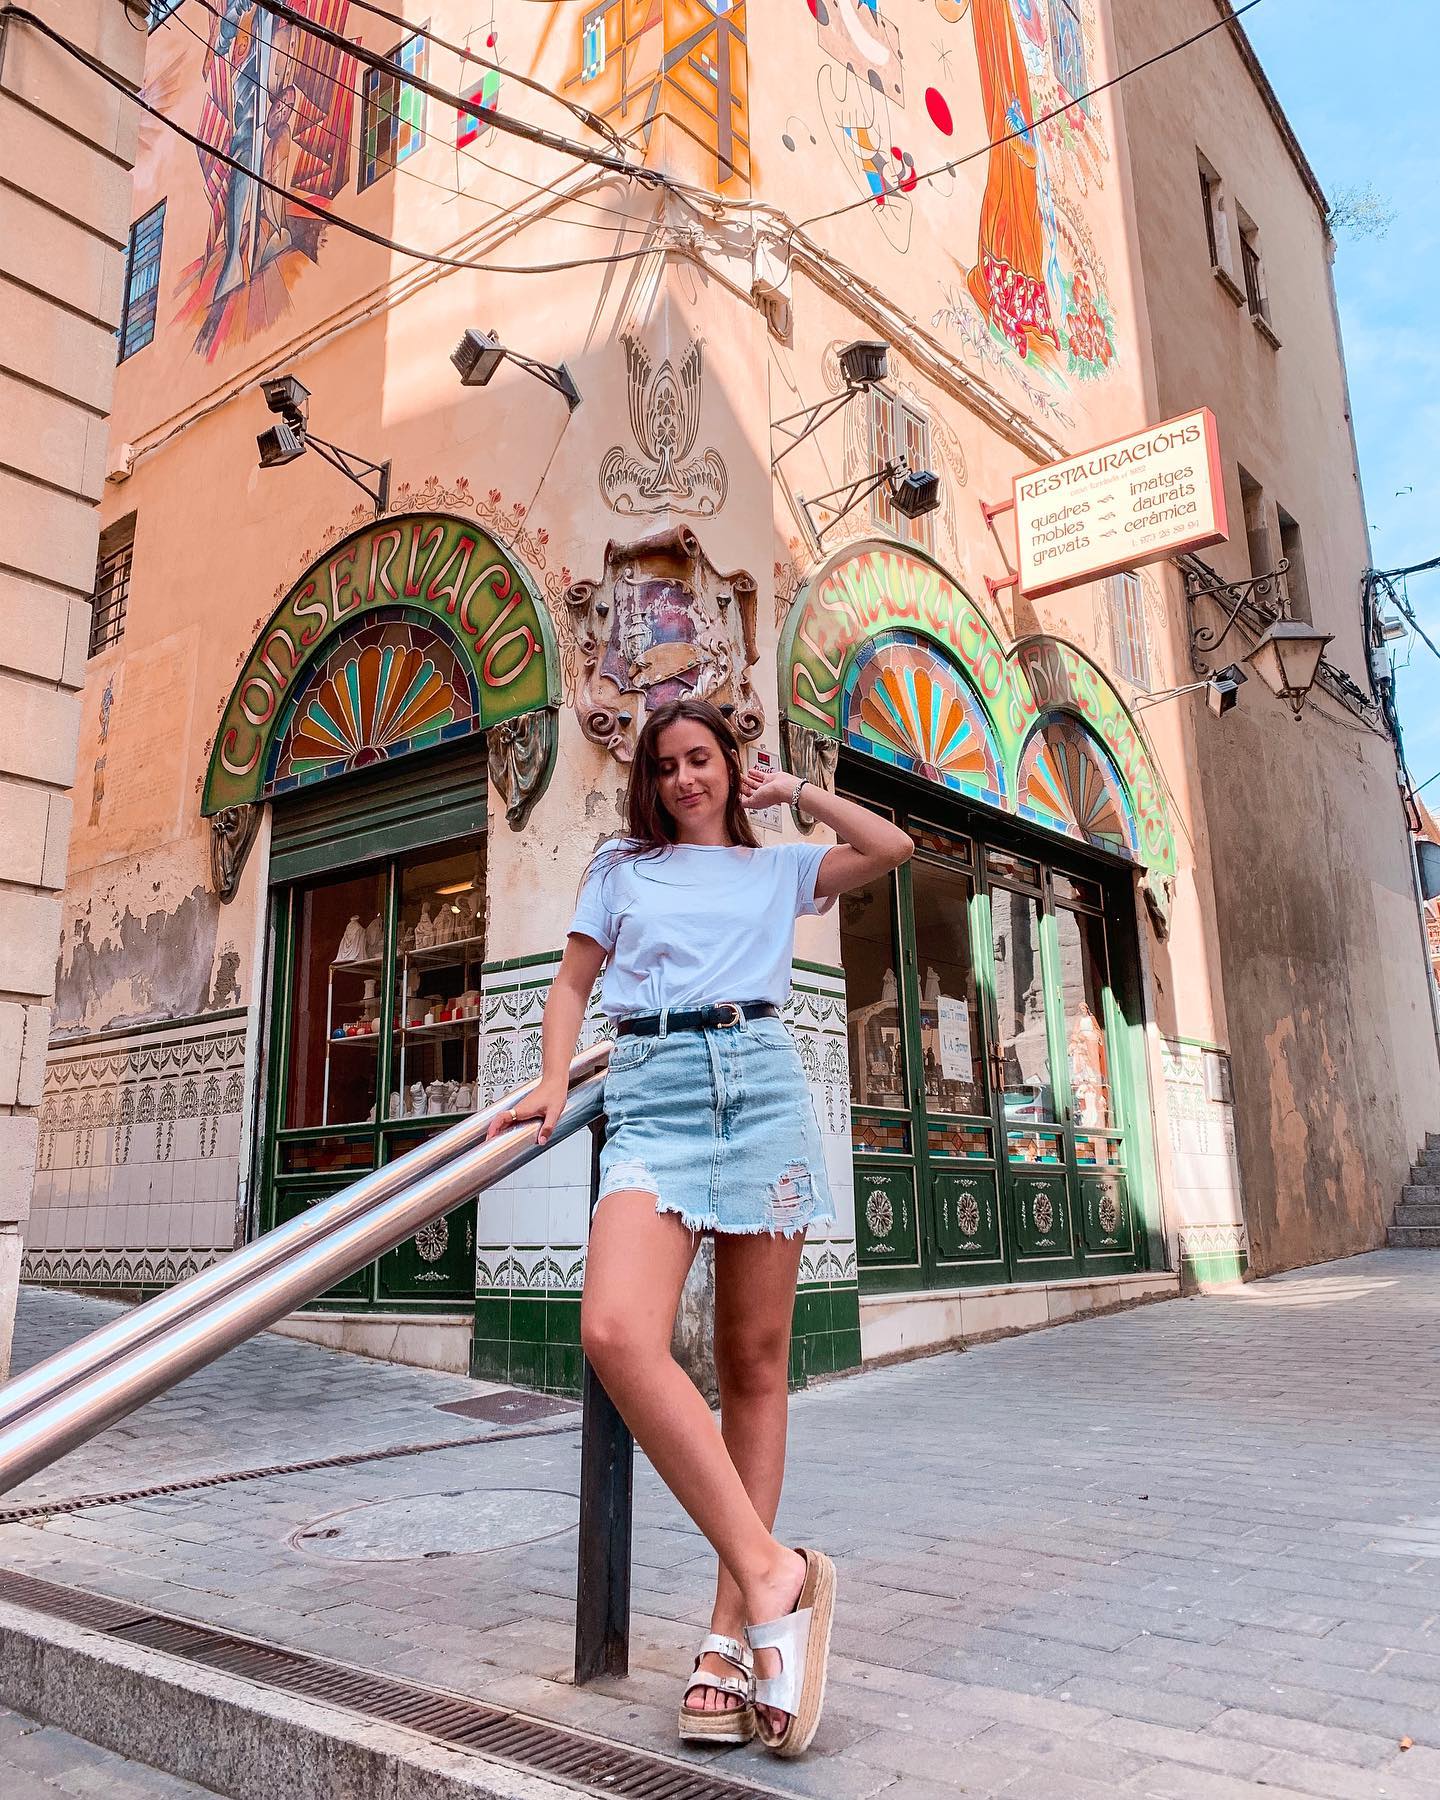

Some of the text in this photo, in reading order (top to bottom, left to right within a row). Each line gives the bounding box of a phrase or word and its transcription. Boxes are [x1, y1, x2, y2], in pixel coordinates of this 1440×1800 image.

[1031, 465, 1194, 532] quadres imatges
[1032, 482, 1195, 547] mobles daurats
[1033, 535, 1090, 567] gravats
